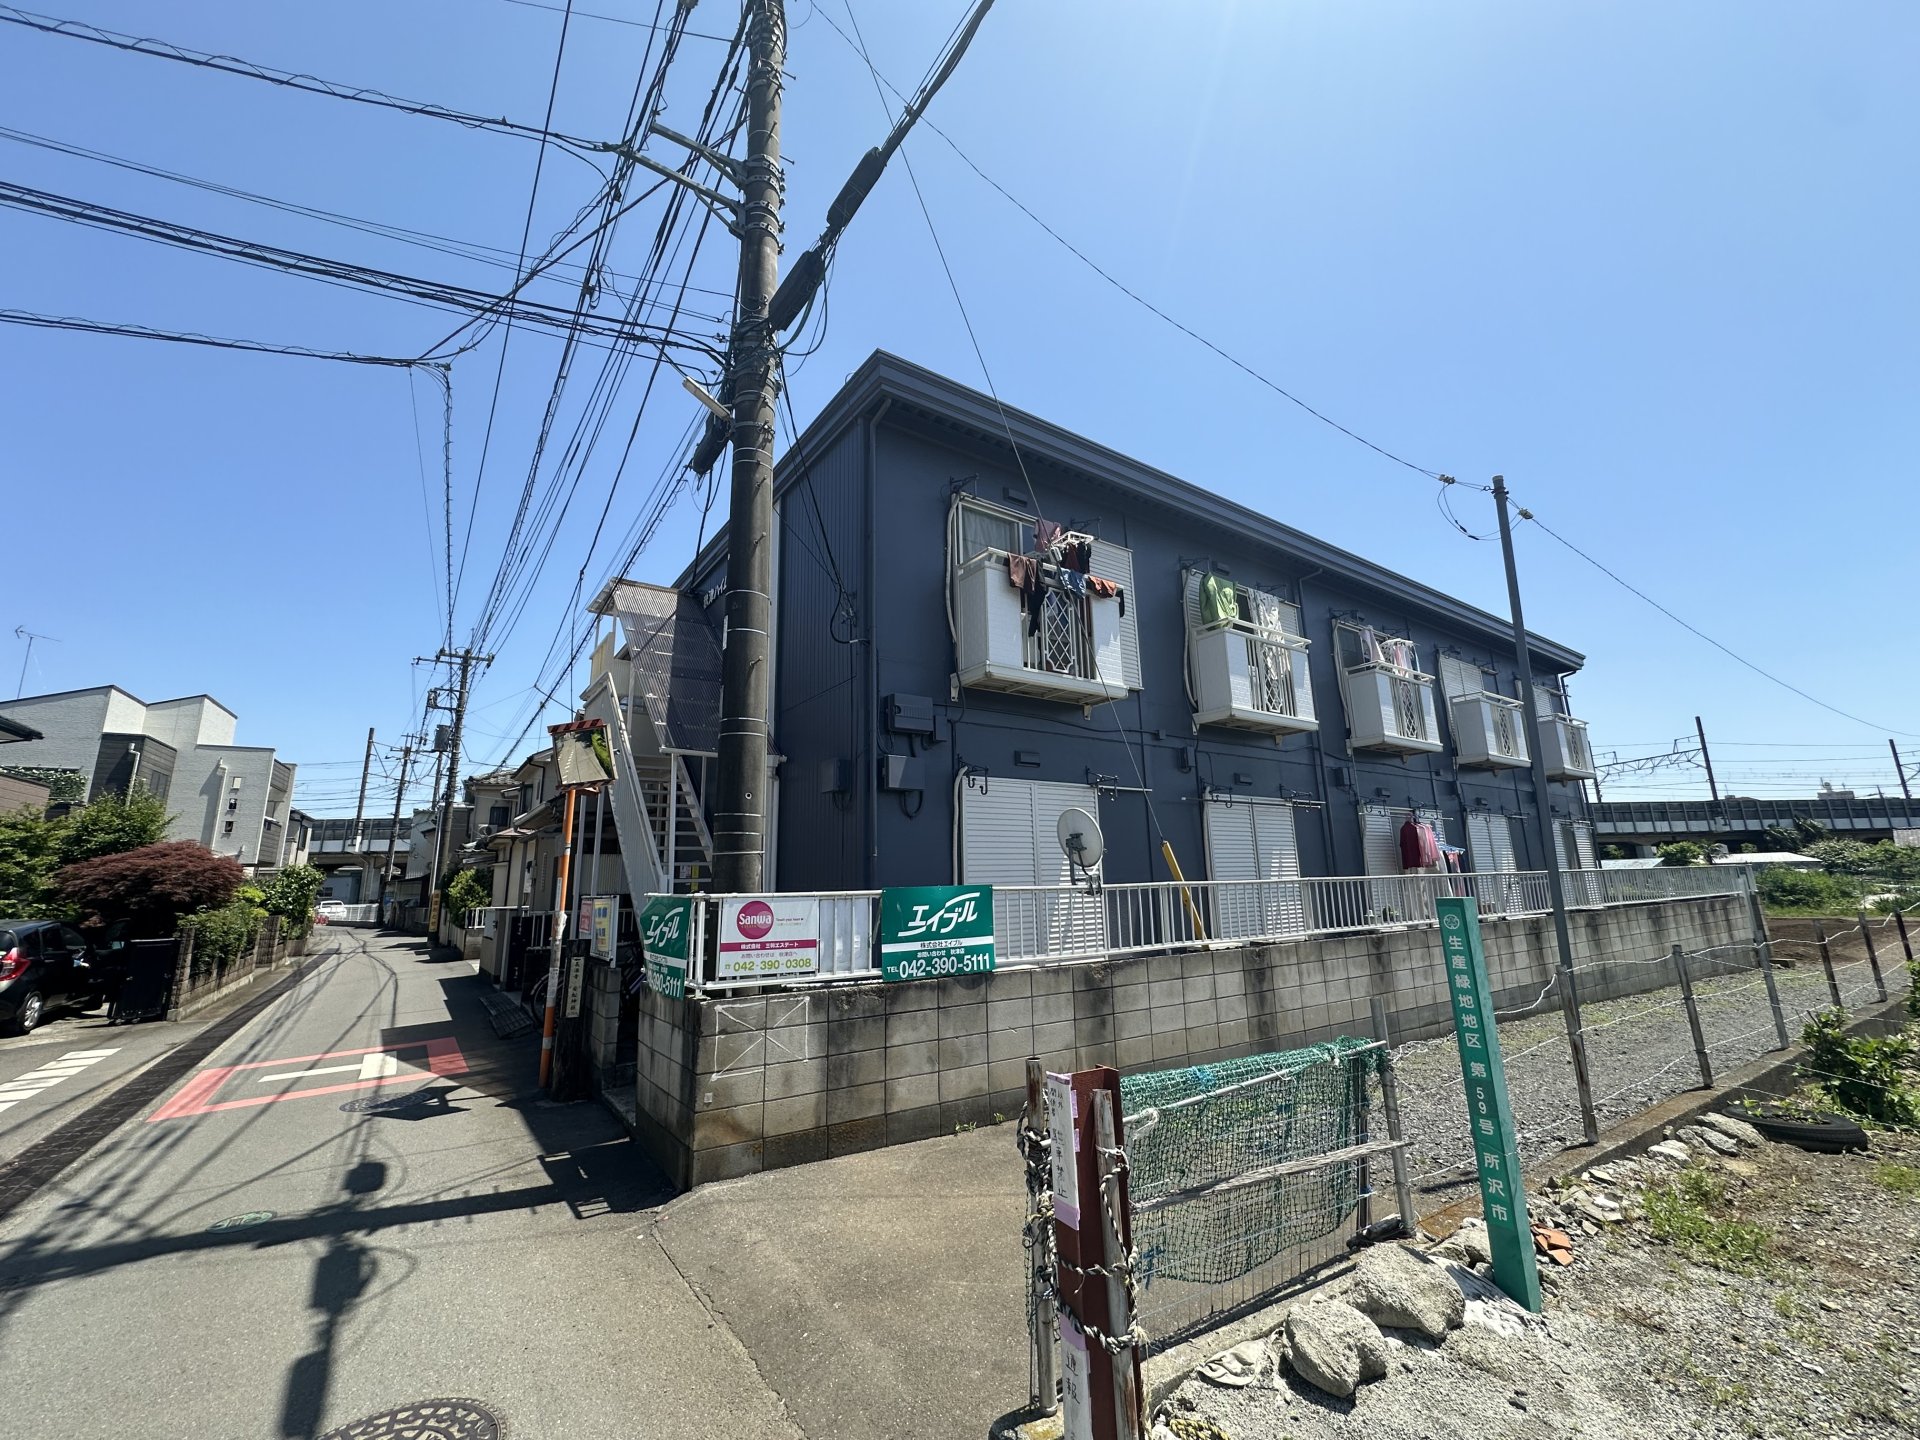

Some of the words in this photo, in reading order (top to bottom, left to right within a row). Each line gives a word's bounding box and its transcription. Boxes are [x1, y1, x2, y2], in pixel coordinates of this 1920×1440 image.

[739, 913, 772, 925] Sanwa
[898, 892, 980, 937] エイブル
[644, 907, 684, 947] エイブル
[740, 942, 761, 950] 株式会社
[765, 941, 799, 949] 三和エステート
[920, 939, 963, 949] 株式会社エイブル
[733, 958, 811, 972] 042-390-0308
[899, 953, 990, 978] 042-390-5111
[1447, 935, 1482, 1049] 生産緑地地区
[1469, 1061, 1495, 1136] 第59号
[1483, 1151, 1508, 1222] 所沢市
